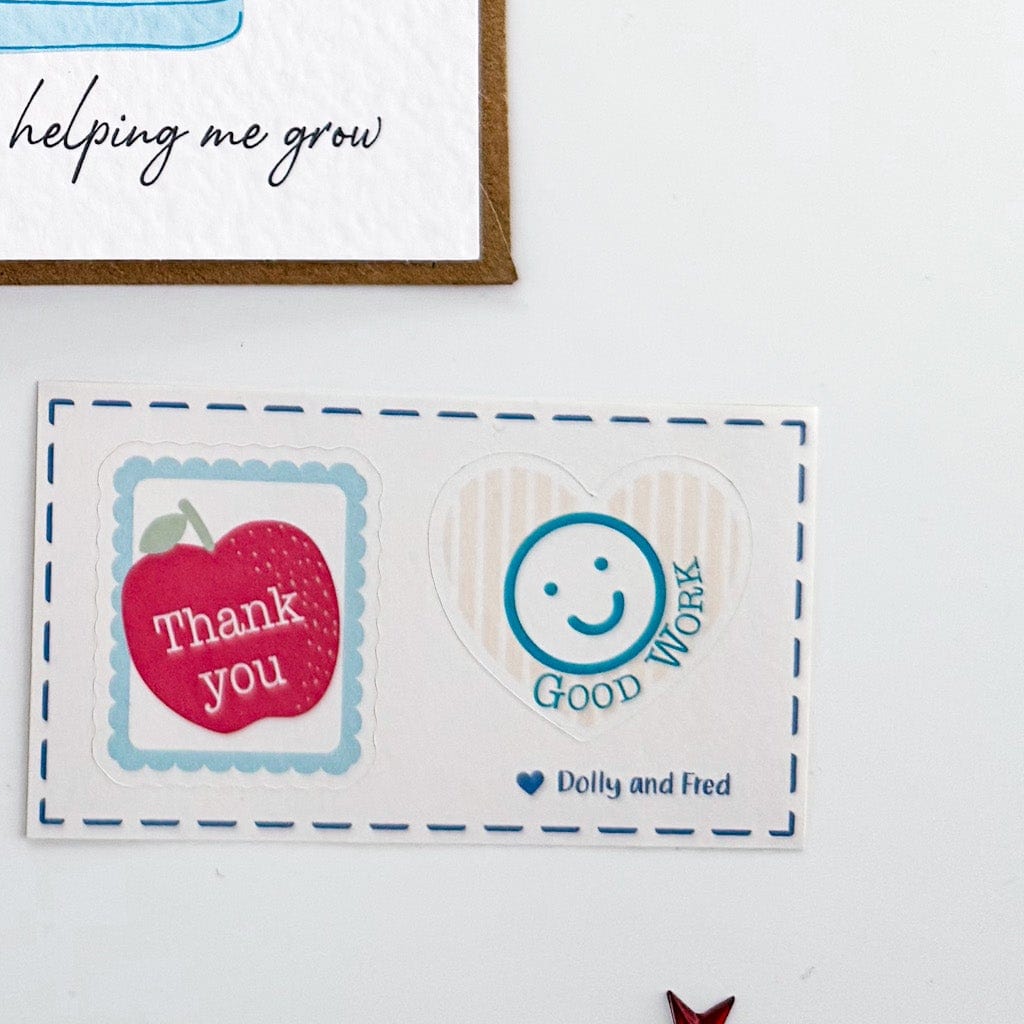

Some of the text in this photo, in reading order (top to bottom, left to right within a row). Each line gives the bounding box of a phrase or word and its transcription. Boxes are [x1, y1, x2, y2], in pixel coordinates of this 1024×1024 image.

[9, 74, 190, 185] helping
[200, 123, 269, 149] me
[268, 116, 382, 188] grow
[153, 585, 305, 654] Thank
[532, 555, 703, 713] GOOD WORK
[198, 655, 287, 714] you
[557, 769, 732, 800] Dolly and Fred
